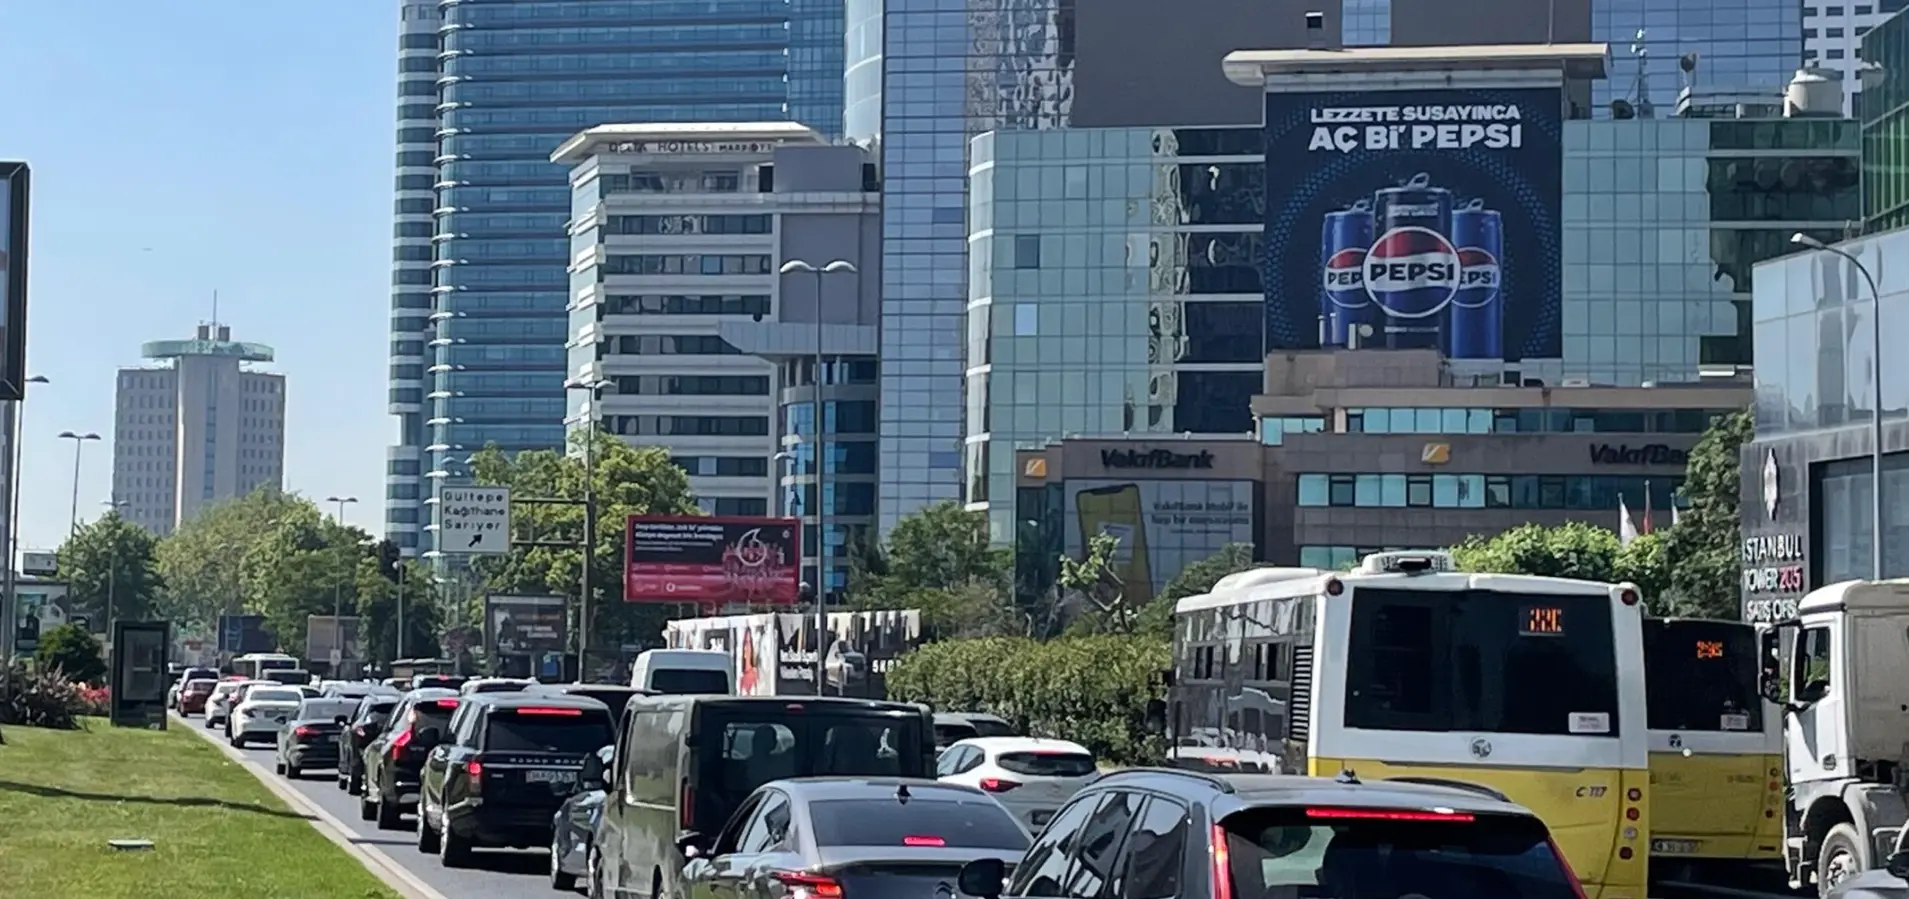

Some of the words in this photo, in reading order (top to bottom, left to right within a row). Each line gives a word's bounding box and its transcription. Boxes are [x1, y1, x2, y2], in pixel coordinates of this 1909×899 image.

[1310, 106, 1400, 123] LEZZETE
[1402, 104, 1521, 121] SUSAYINCA
[1308, 126, 1358, 153] AÇ
[1411, 123, 1522, 149] PEPSI
[1328, 271, 1363, 285] PEP
[1370, 263, 1454, 281] PEPSI
[1461, 270, 1497, 285] EPSI
[1779, 566, 1801, 589] 205
